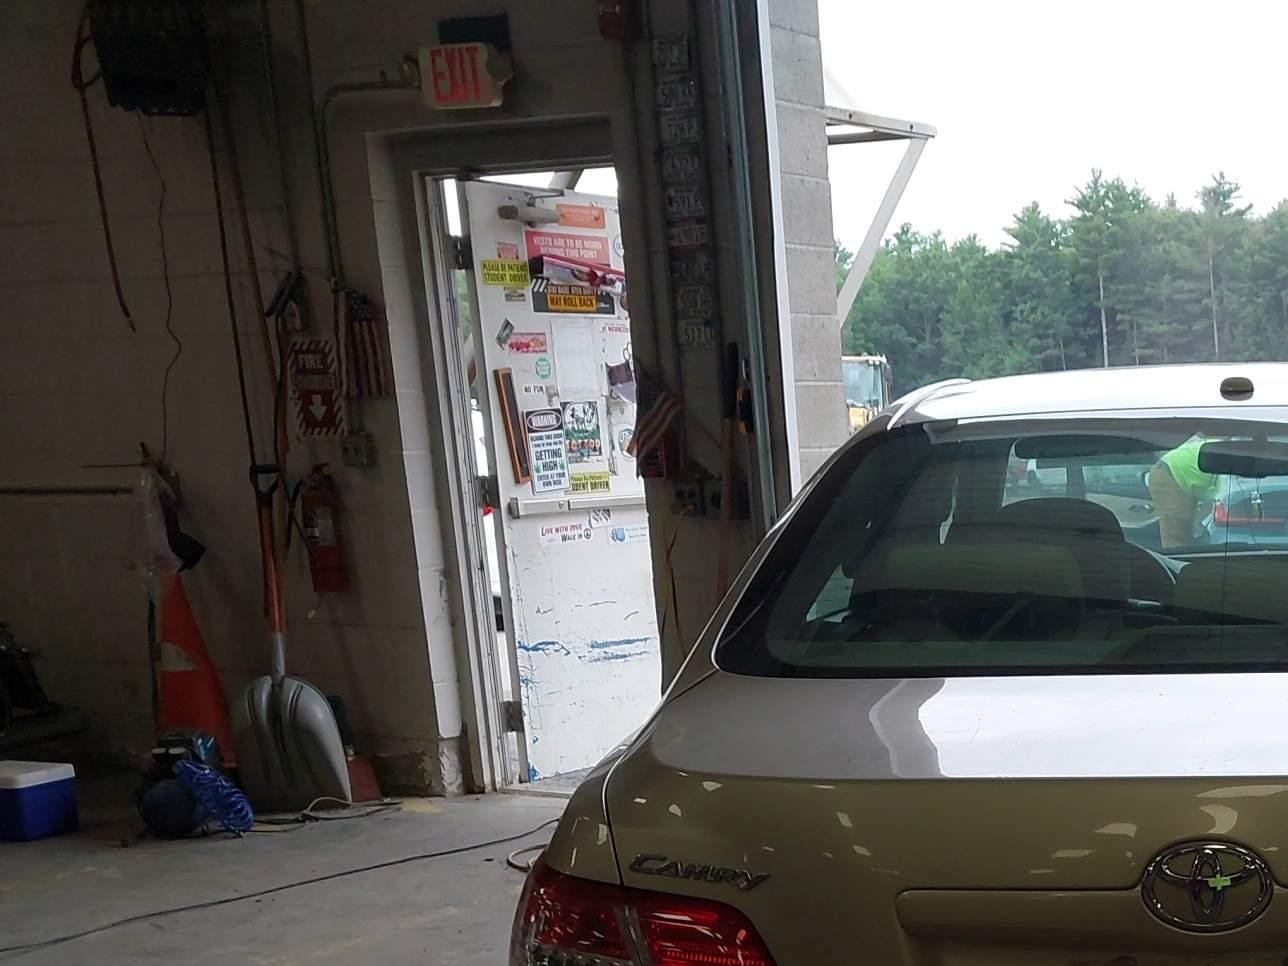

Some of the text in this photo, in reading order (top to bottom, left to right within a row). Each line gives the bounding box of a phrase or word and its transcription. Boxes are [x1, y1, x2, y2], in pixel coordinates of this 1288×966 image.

[430, 47, 481, 103] EXIT
[553, 238, 566, 248] ARE
[567, 239, 575, 248] TO
[575, 240, 583, 249] BE
[482, 262, 500, 272] PLEASE
[501, 263, 508, 272] BE
[484, 273, 507, 282] STUDENT
[549, 295, 595, 308] MAY ROLL BACK
[298, 353, 324, 369] FIRE
[531, 414, 557, 427] WARNING
[535, 448, 562, 461] GETTING
[542, 460, 558, 472] HIGH
[537, 474, 550, 482] ENTER
[543, 480, 552, 488] OWN
[590, 480, 609, 490] DRIVER
[630, 854, 770, 890] CAMRY
